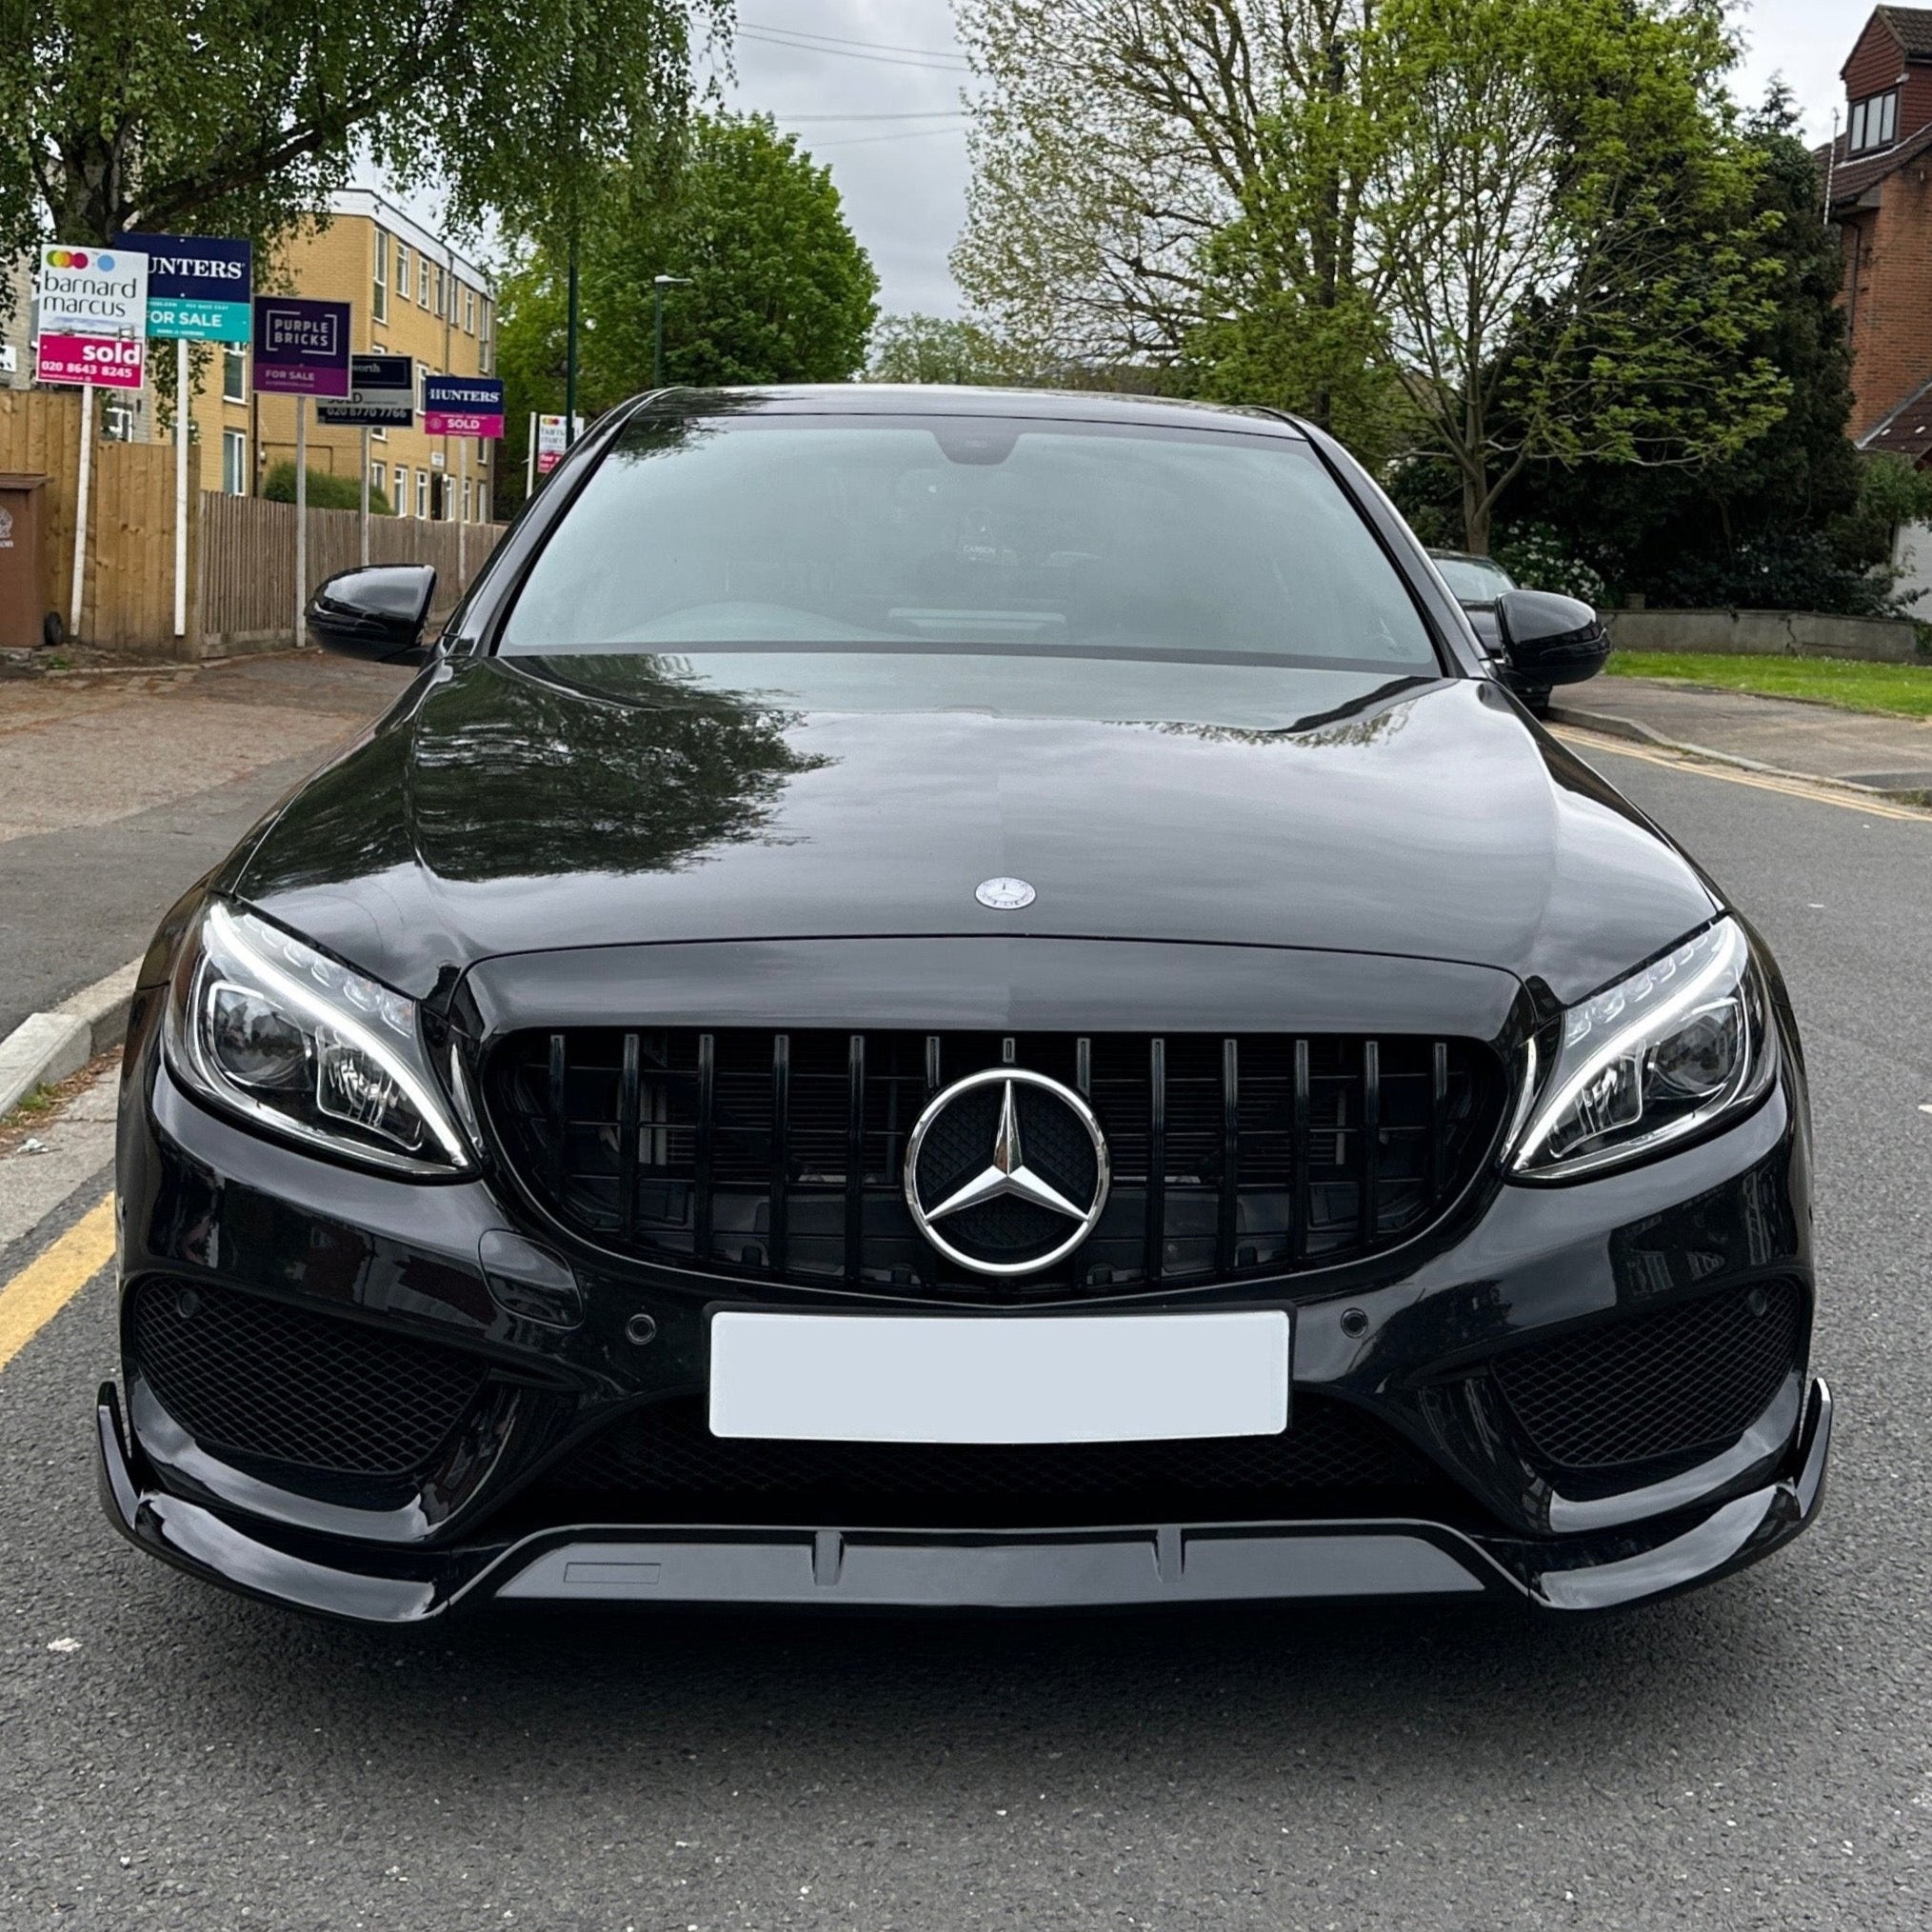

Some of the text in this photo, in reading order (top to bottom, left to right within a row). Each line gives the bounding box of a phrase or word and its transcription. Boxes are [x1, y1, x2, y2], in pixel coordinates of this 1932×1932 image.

[44, 270, 136, 298] barnard
[44, 296, 126, 317] marcus
[146, 310, 223, 328] OR SALE
[274, 319, 329, 333] PURPLE
[274, 331, 329, 347] BRICKS
[82, 342, 141, 365] sold
[41, 361, 132, 378] 020 8643 8245
[265, 369, 315, 381] FOR SALE
[428, 388, 501, 403] HUNTERS
[447, 418, 481, 429] SOLD
